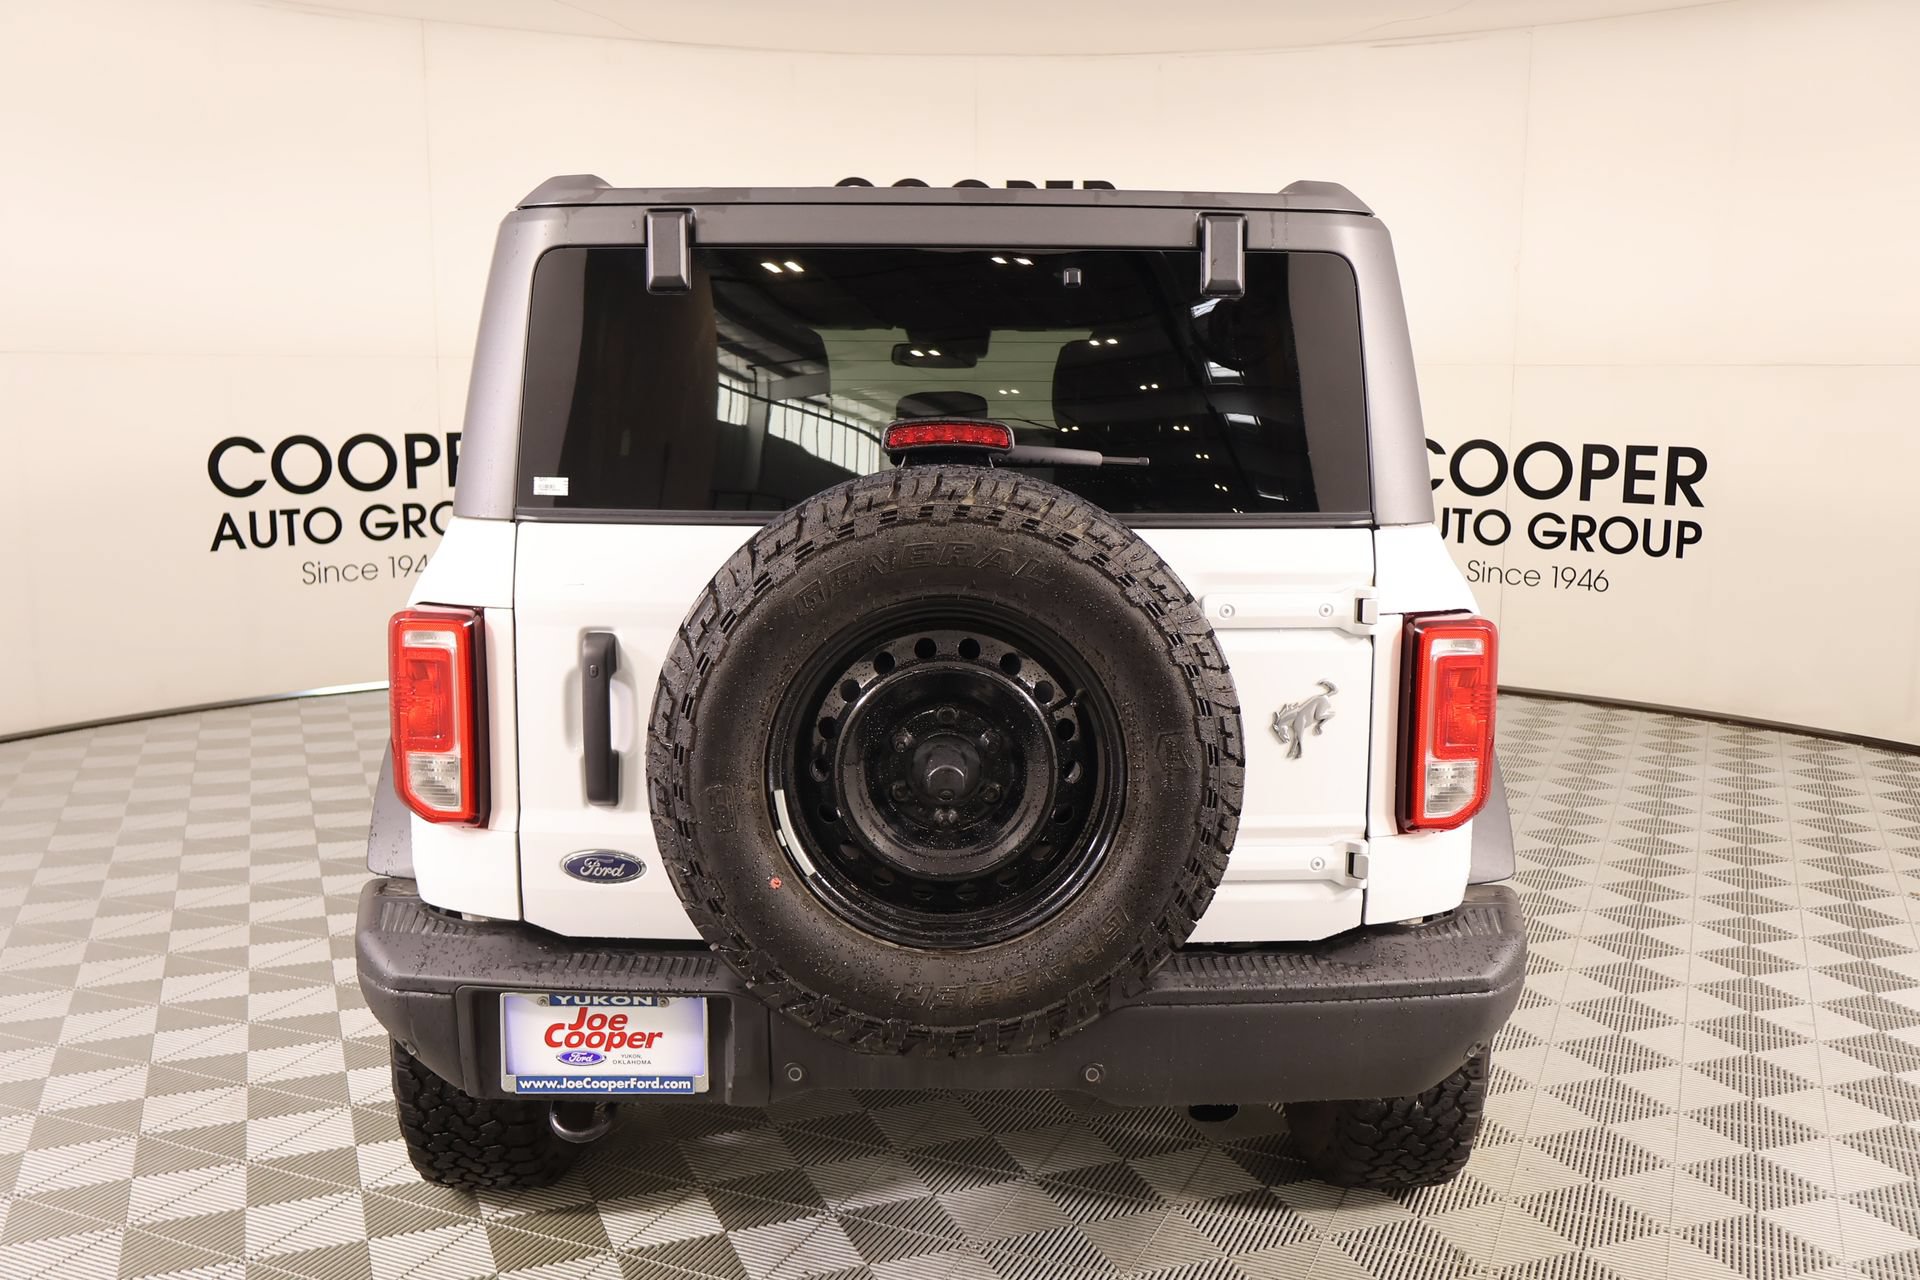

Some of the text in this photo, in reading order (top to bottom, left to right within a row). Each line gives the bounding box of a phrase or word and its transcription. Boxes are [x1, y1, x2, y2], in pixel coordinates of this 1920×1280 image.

[210, 507, 343, 552] AUTO
[1527, 511, 1703, 559] GROUP
[302, 558, 379, 585] Since
[790, 540, 1052, 616] GENERAL
[1466, 560, 1610, 593] Since 1946
[580, 857, 626, 877] Ford
[555, 995, 652, 1006] YUKON
[568, 1006, 629, 1031] Joe
[544, 1023, 663, 1052] Cooper
[569, 1052, 594, 1063] Ford
[519, 1077, 691, 1091] www.JoeCooperFord.com
